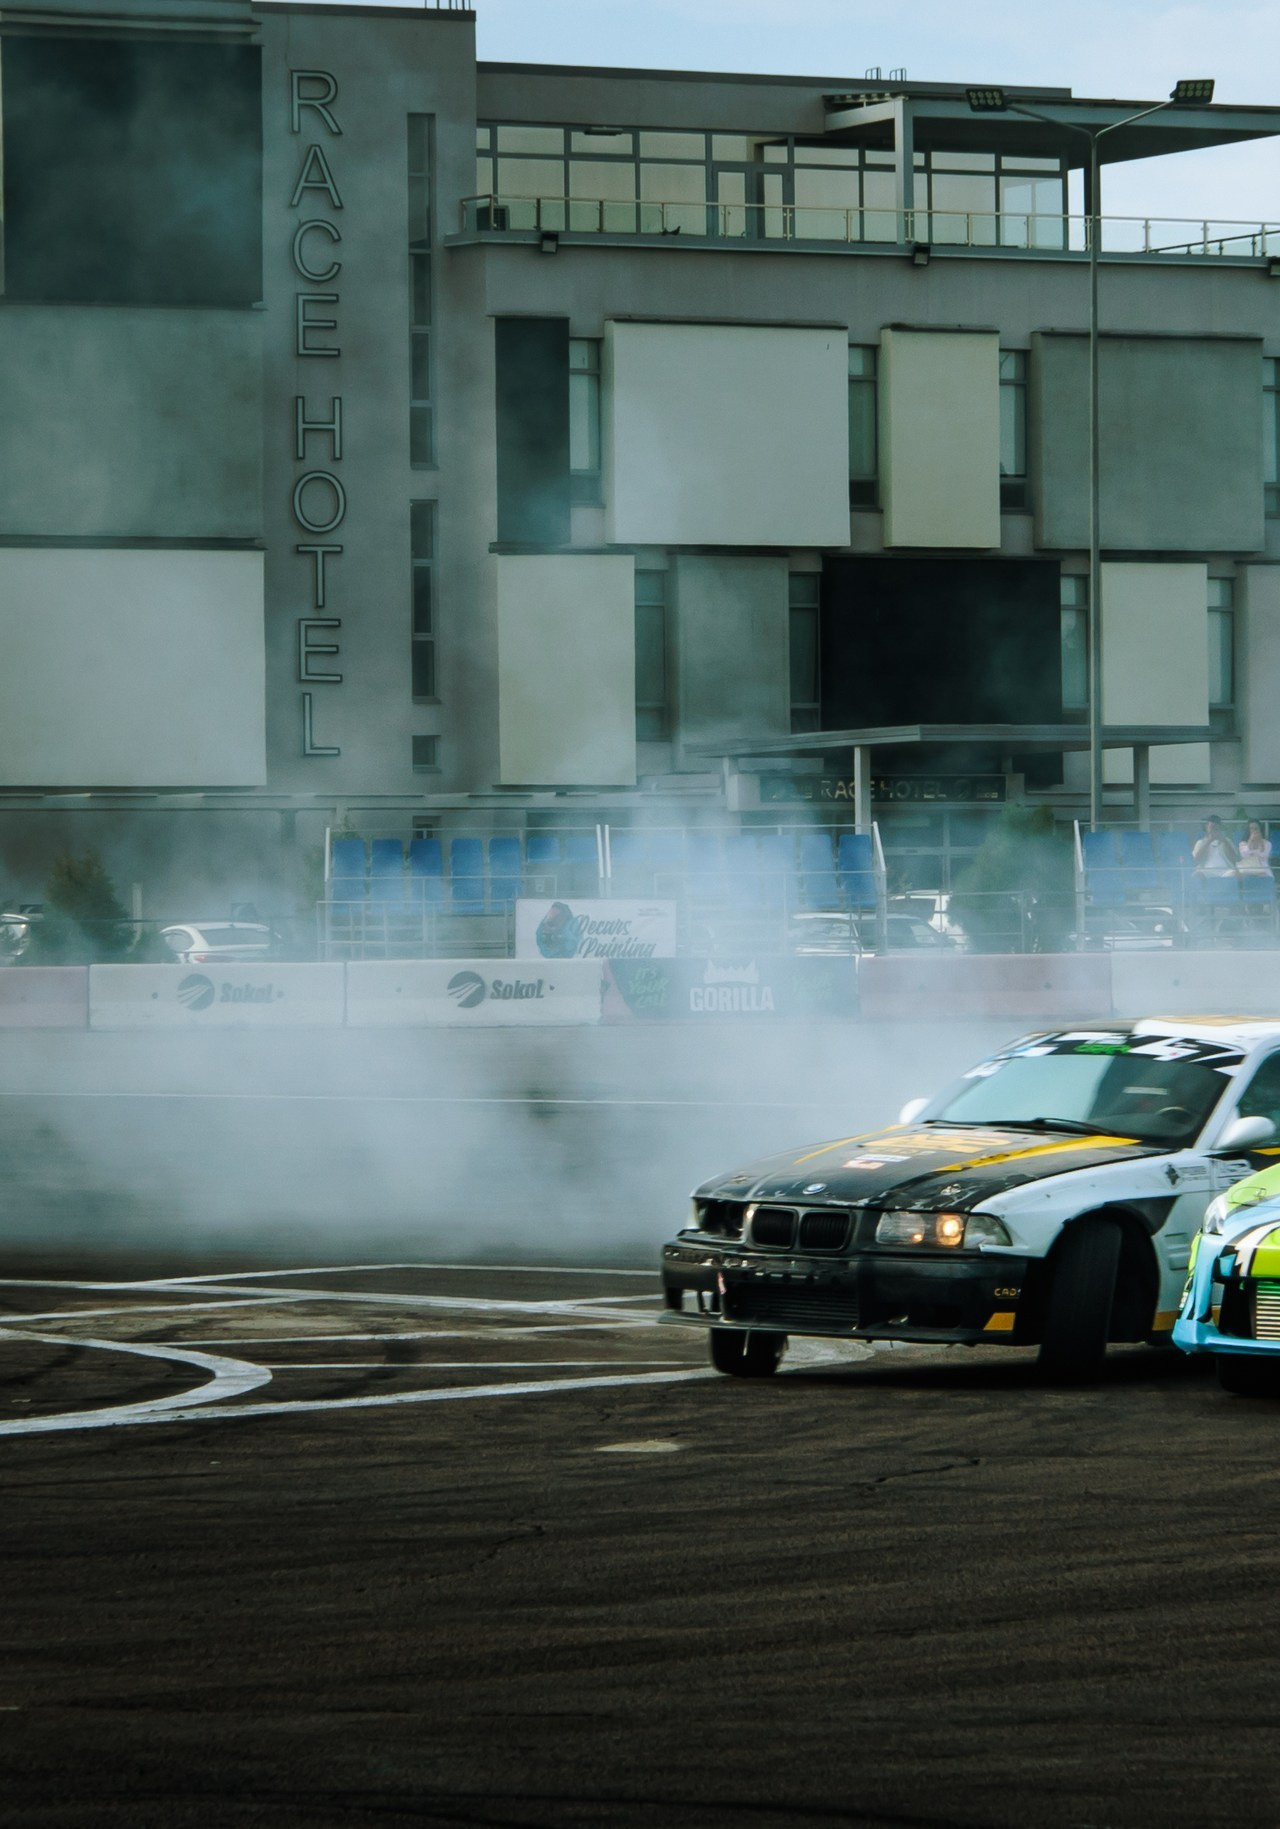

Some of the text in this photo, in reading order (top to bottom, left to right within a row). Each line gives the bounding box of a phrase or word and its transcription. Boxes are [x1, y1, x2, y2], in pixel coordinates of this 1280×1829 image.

[290, 69, 346, 756] RACE HOTEL
[689, 986, 775, 1012] GORILLA
